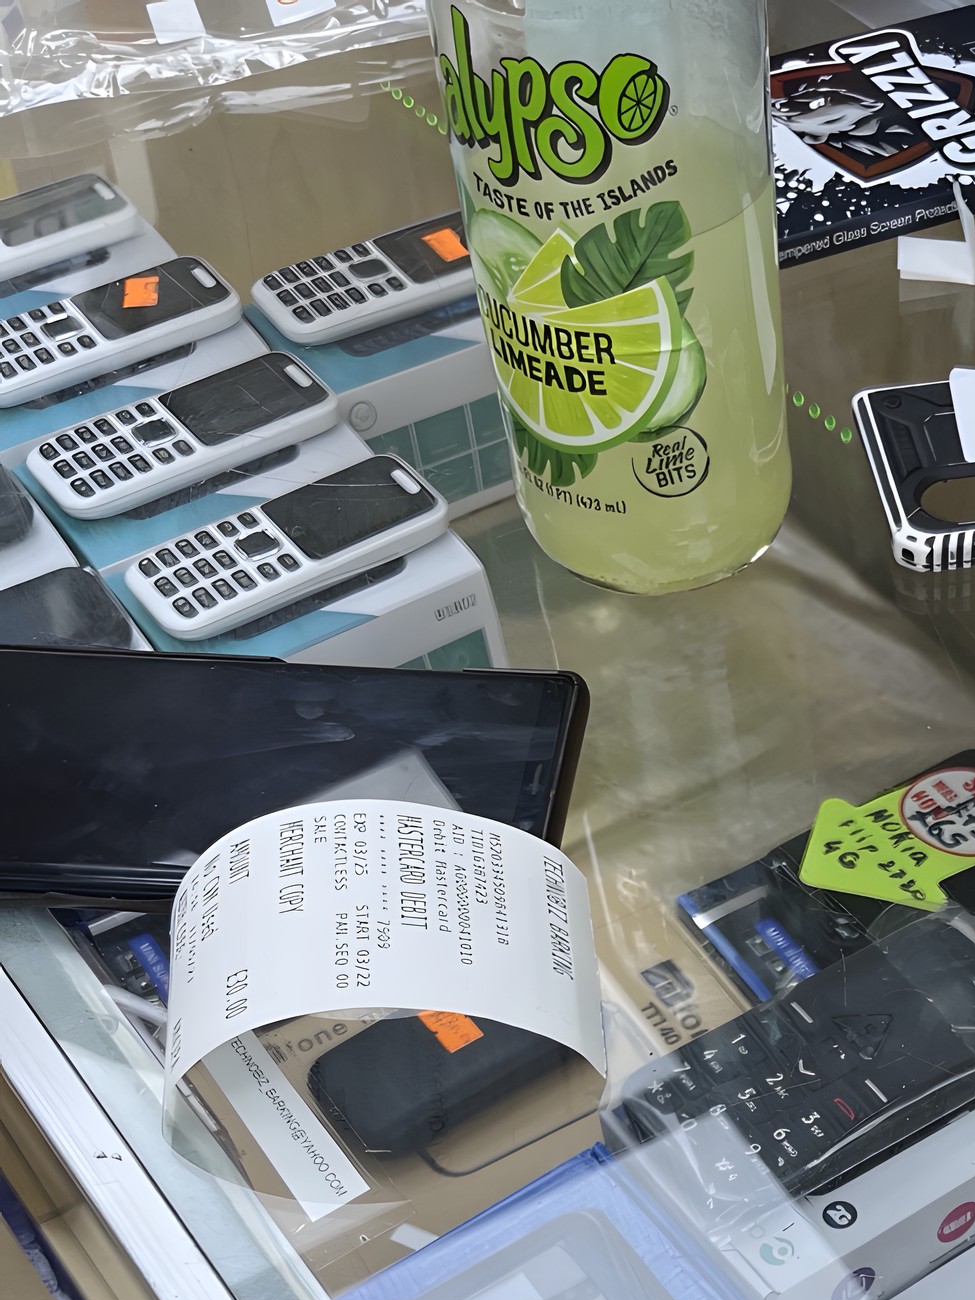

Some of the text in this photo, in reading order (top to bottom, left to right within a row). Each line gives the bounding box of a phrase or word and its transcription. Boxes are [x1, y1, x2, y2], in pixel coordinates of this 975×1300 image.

[438, 4, 671, 188] alypso
[472, 159, 679, 221] TASTE OF THE ISLANDS
[778, 234, 832, 264] empered
[869, 211, 913, 236] Screen
[479, 284, 617, 365] CUCUMBER
[489, 327, 608, 396] LIMEADE
[645, 446, 696, 475] Lime
[651, 435, 687, 459] Real
[655, 463, 698, 489] BITS
[353, 812, 367, 833] EXP
[229, 838, 251, 886] AMOUNT
[278, 819, 305, 915] MERCHANT COPY
[333, 814, 348, 891] CONTACTLESS
[396, 814, 428, 930] MASTERCARD DEBIT
[355, 904, 370, 941] START
[355, 949, 371, 988] 03/22
[549, 924, 575, 982] BARKING
[336, 973, 349, 989] 00
